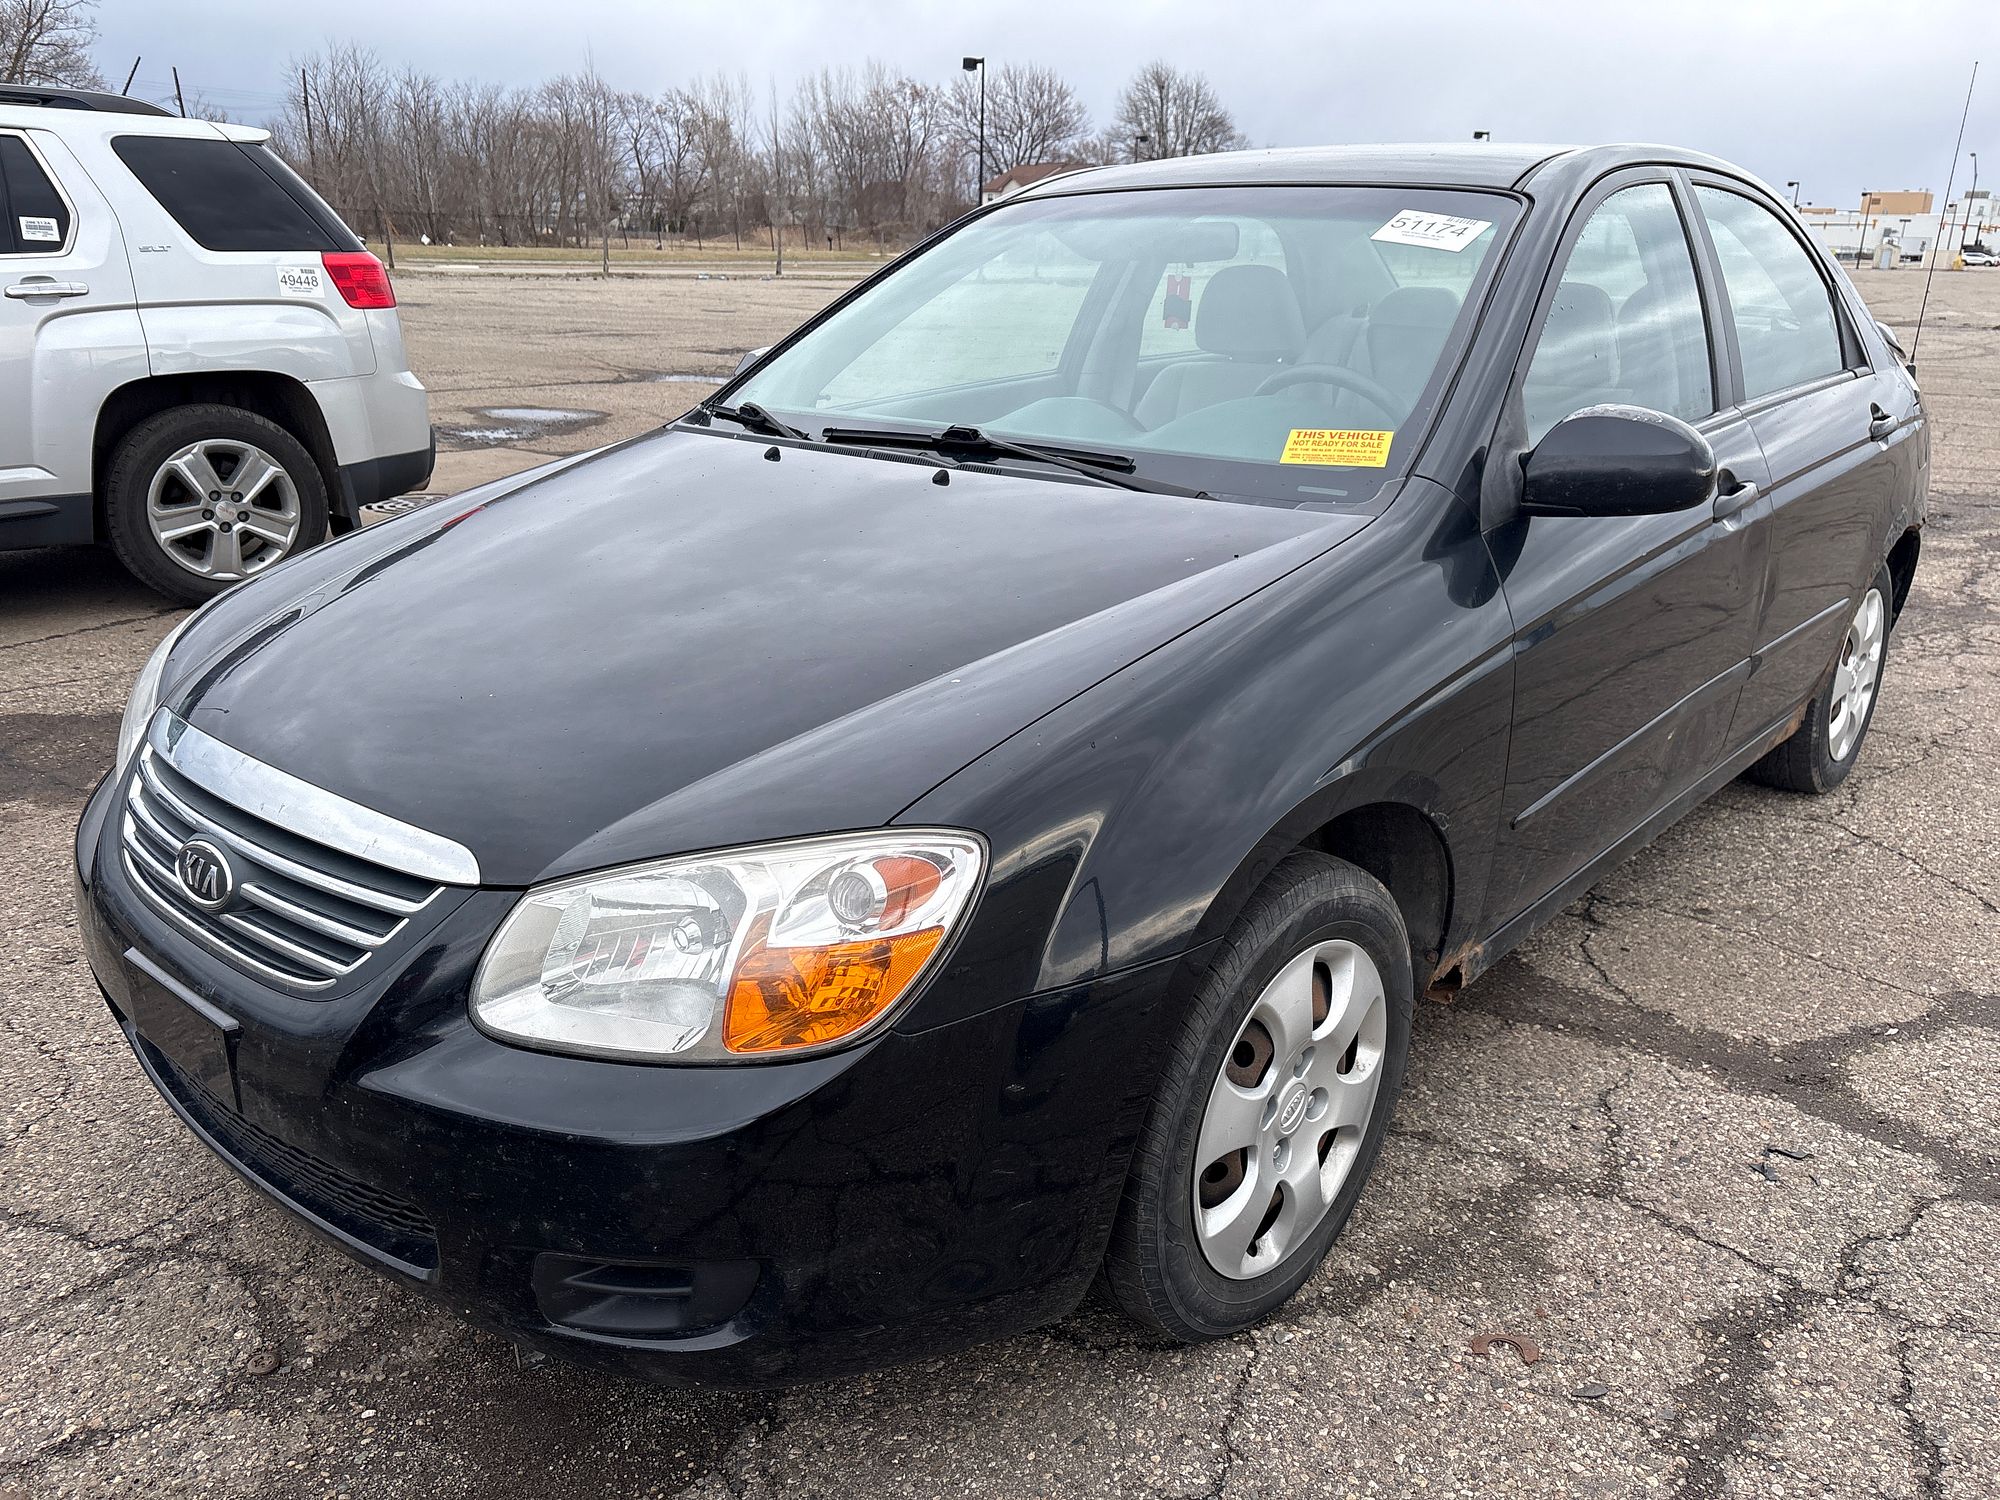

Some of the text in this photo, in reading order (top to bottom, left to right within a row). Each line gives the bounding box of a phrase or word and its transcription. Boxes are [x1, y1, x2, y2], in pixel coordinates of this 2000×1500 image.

[1390, 217, 1469, 237] 51174
[280, 274, 319, 287] 49448
[1295, 431, 1386, 441] THIS VEHICLE
[1341, 440, 1359, 448] FOR
[183, 849, 219, 899] KIA
